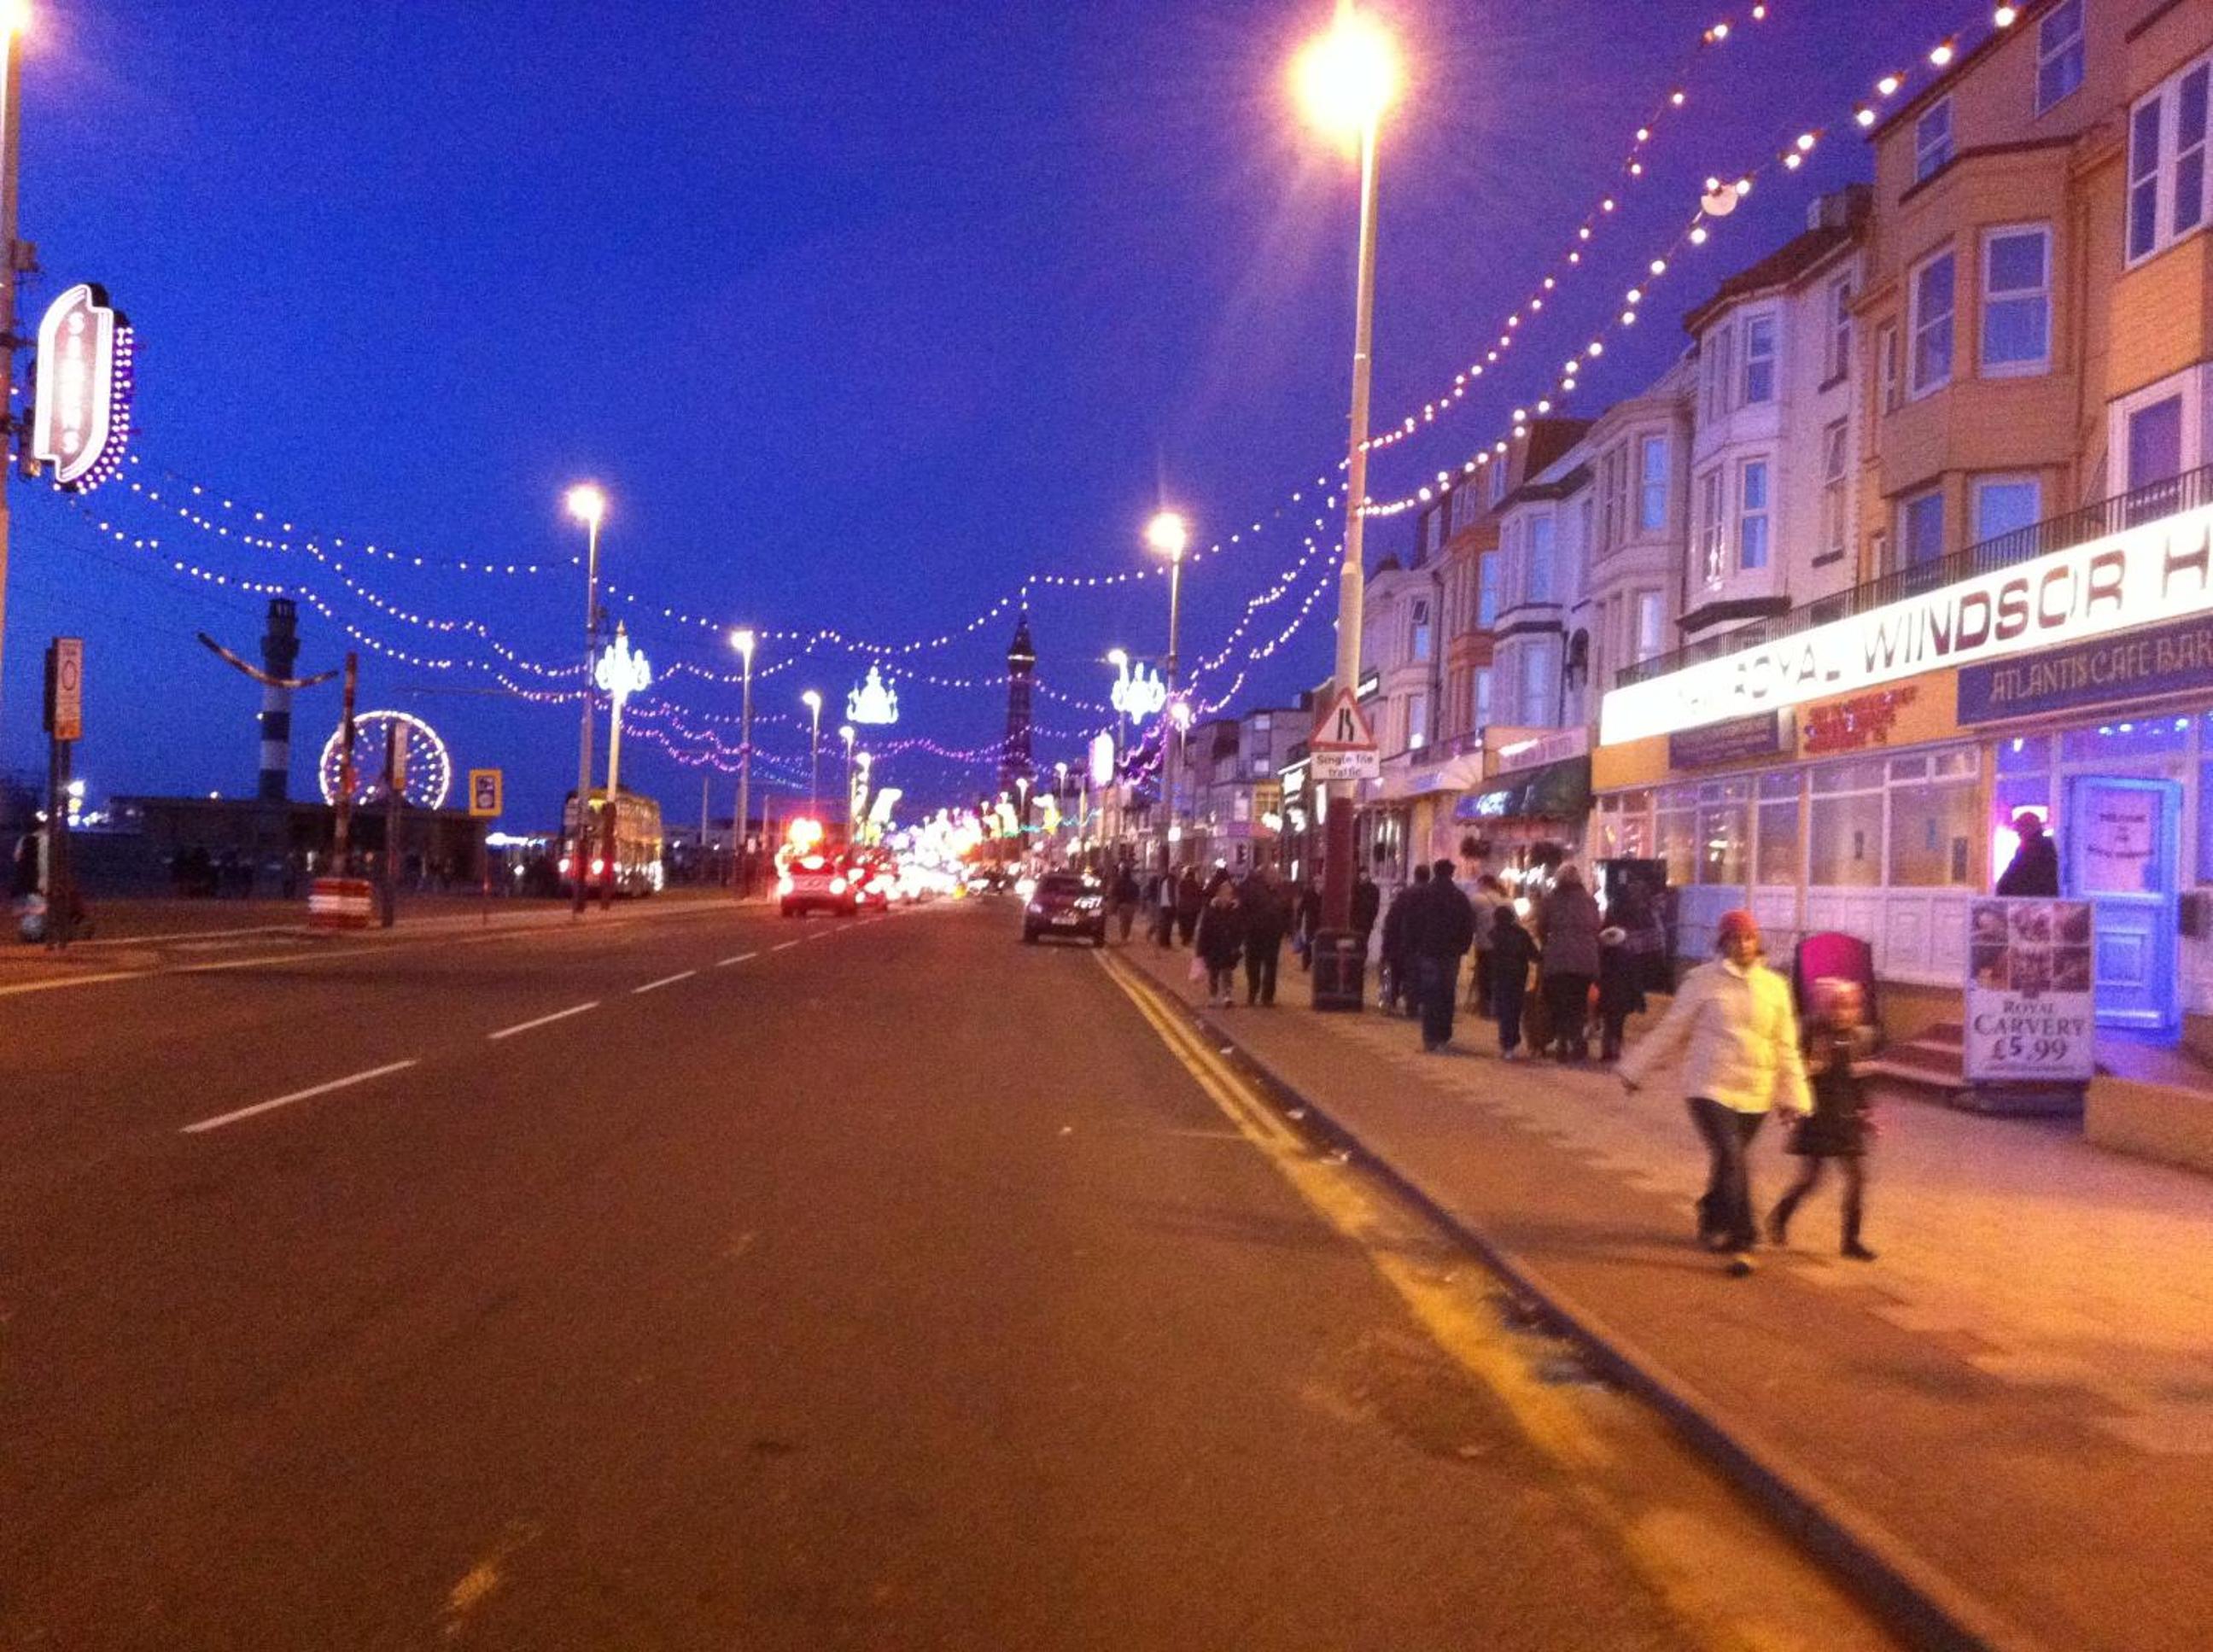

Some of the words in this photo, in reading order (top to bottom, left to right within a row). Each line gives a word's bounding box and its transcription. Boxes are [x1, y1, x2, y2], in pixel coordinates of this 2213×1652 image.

[1730, 639, 1842, 700] OYA
[1864, 549, 2127, 674] WINDSOR
[1991, 651, 2088, 702] ATLANTIS
[2158, 630, 2213, 673] BAR
[1317, 755, 1352, 767] Single
[1328, 767, 1361, 777] traffic
[2004, 1001, 2053, 1013] ROYAL
[1974, 1013, 2083, 1036] CARVERY
[1993, 1036, 2068, 1062] £5.99
